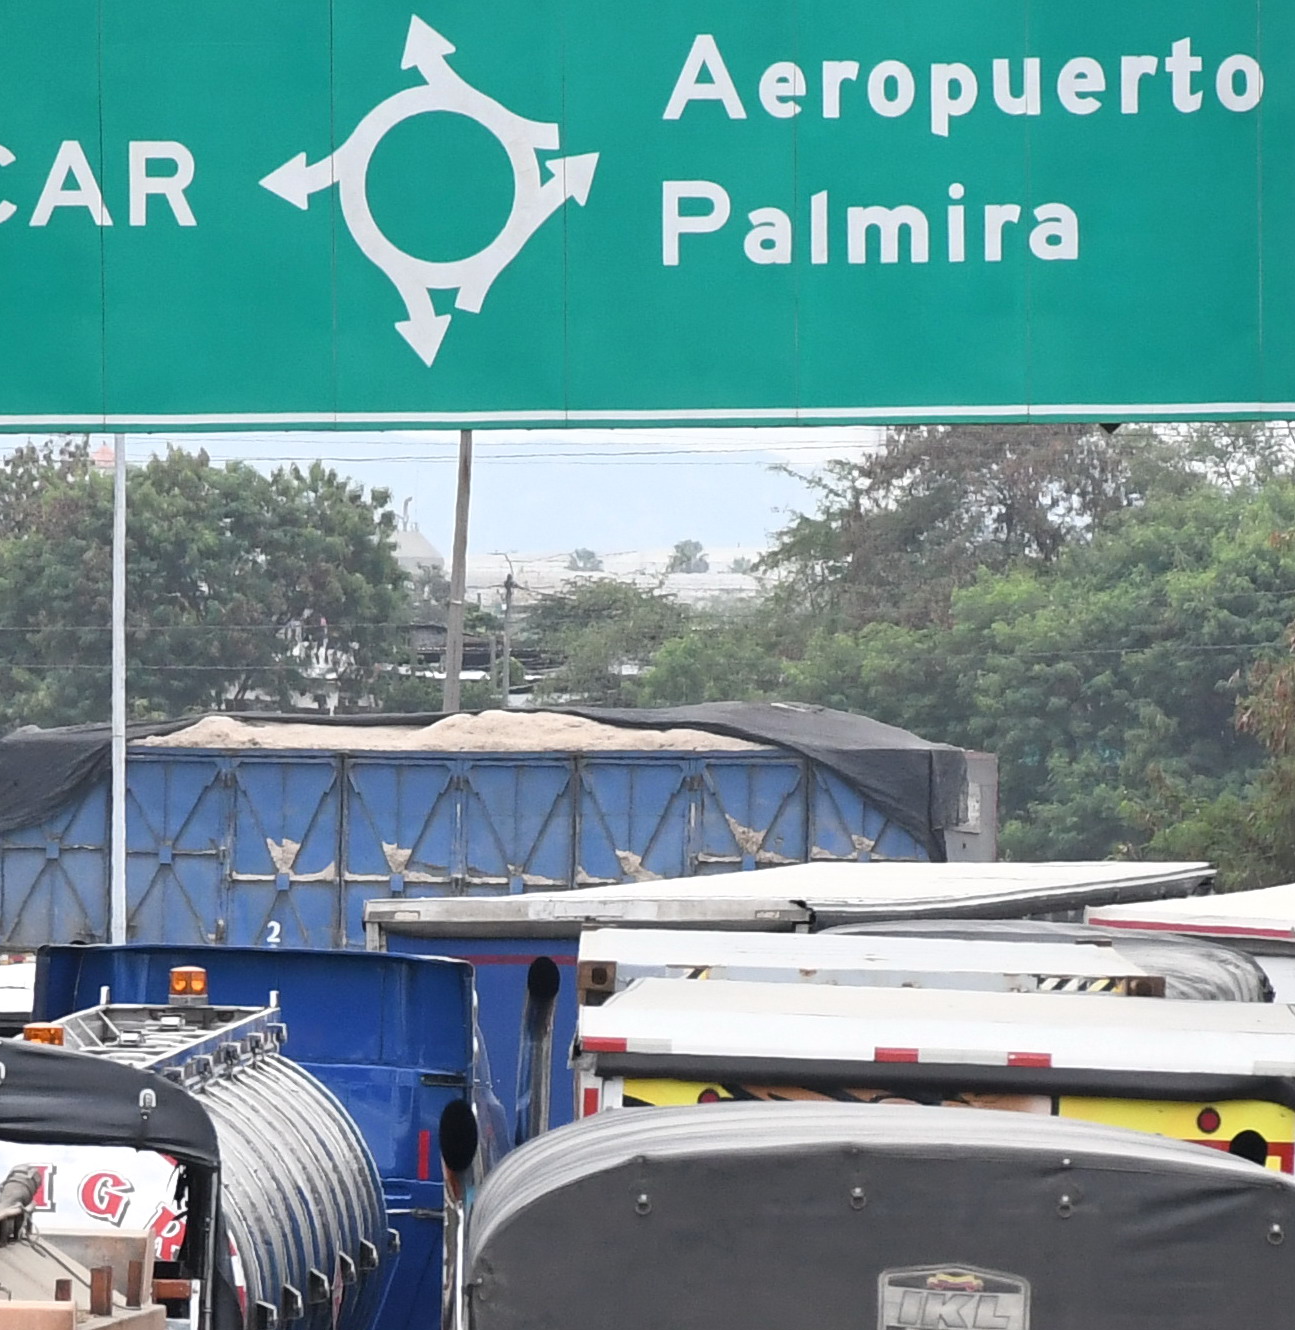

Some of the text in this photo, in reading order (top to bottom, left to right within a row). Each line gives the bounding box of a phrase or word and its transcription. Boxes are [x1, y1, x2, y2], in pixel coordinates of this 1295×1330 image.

[662, 34, 1264, 137] Aeropuerto
[662, 180, 1079, 266] Palmira
[897, 1290, 1011, 1330] IKL
